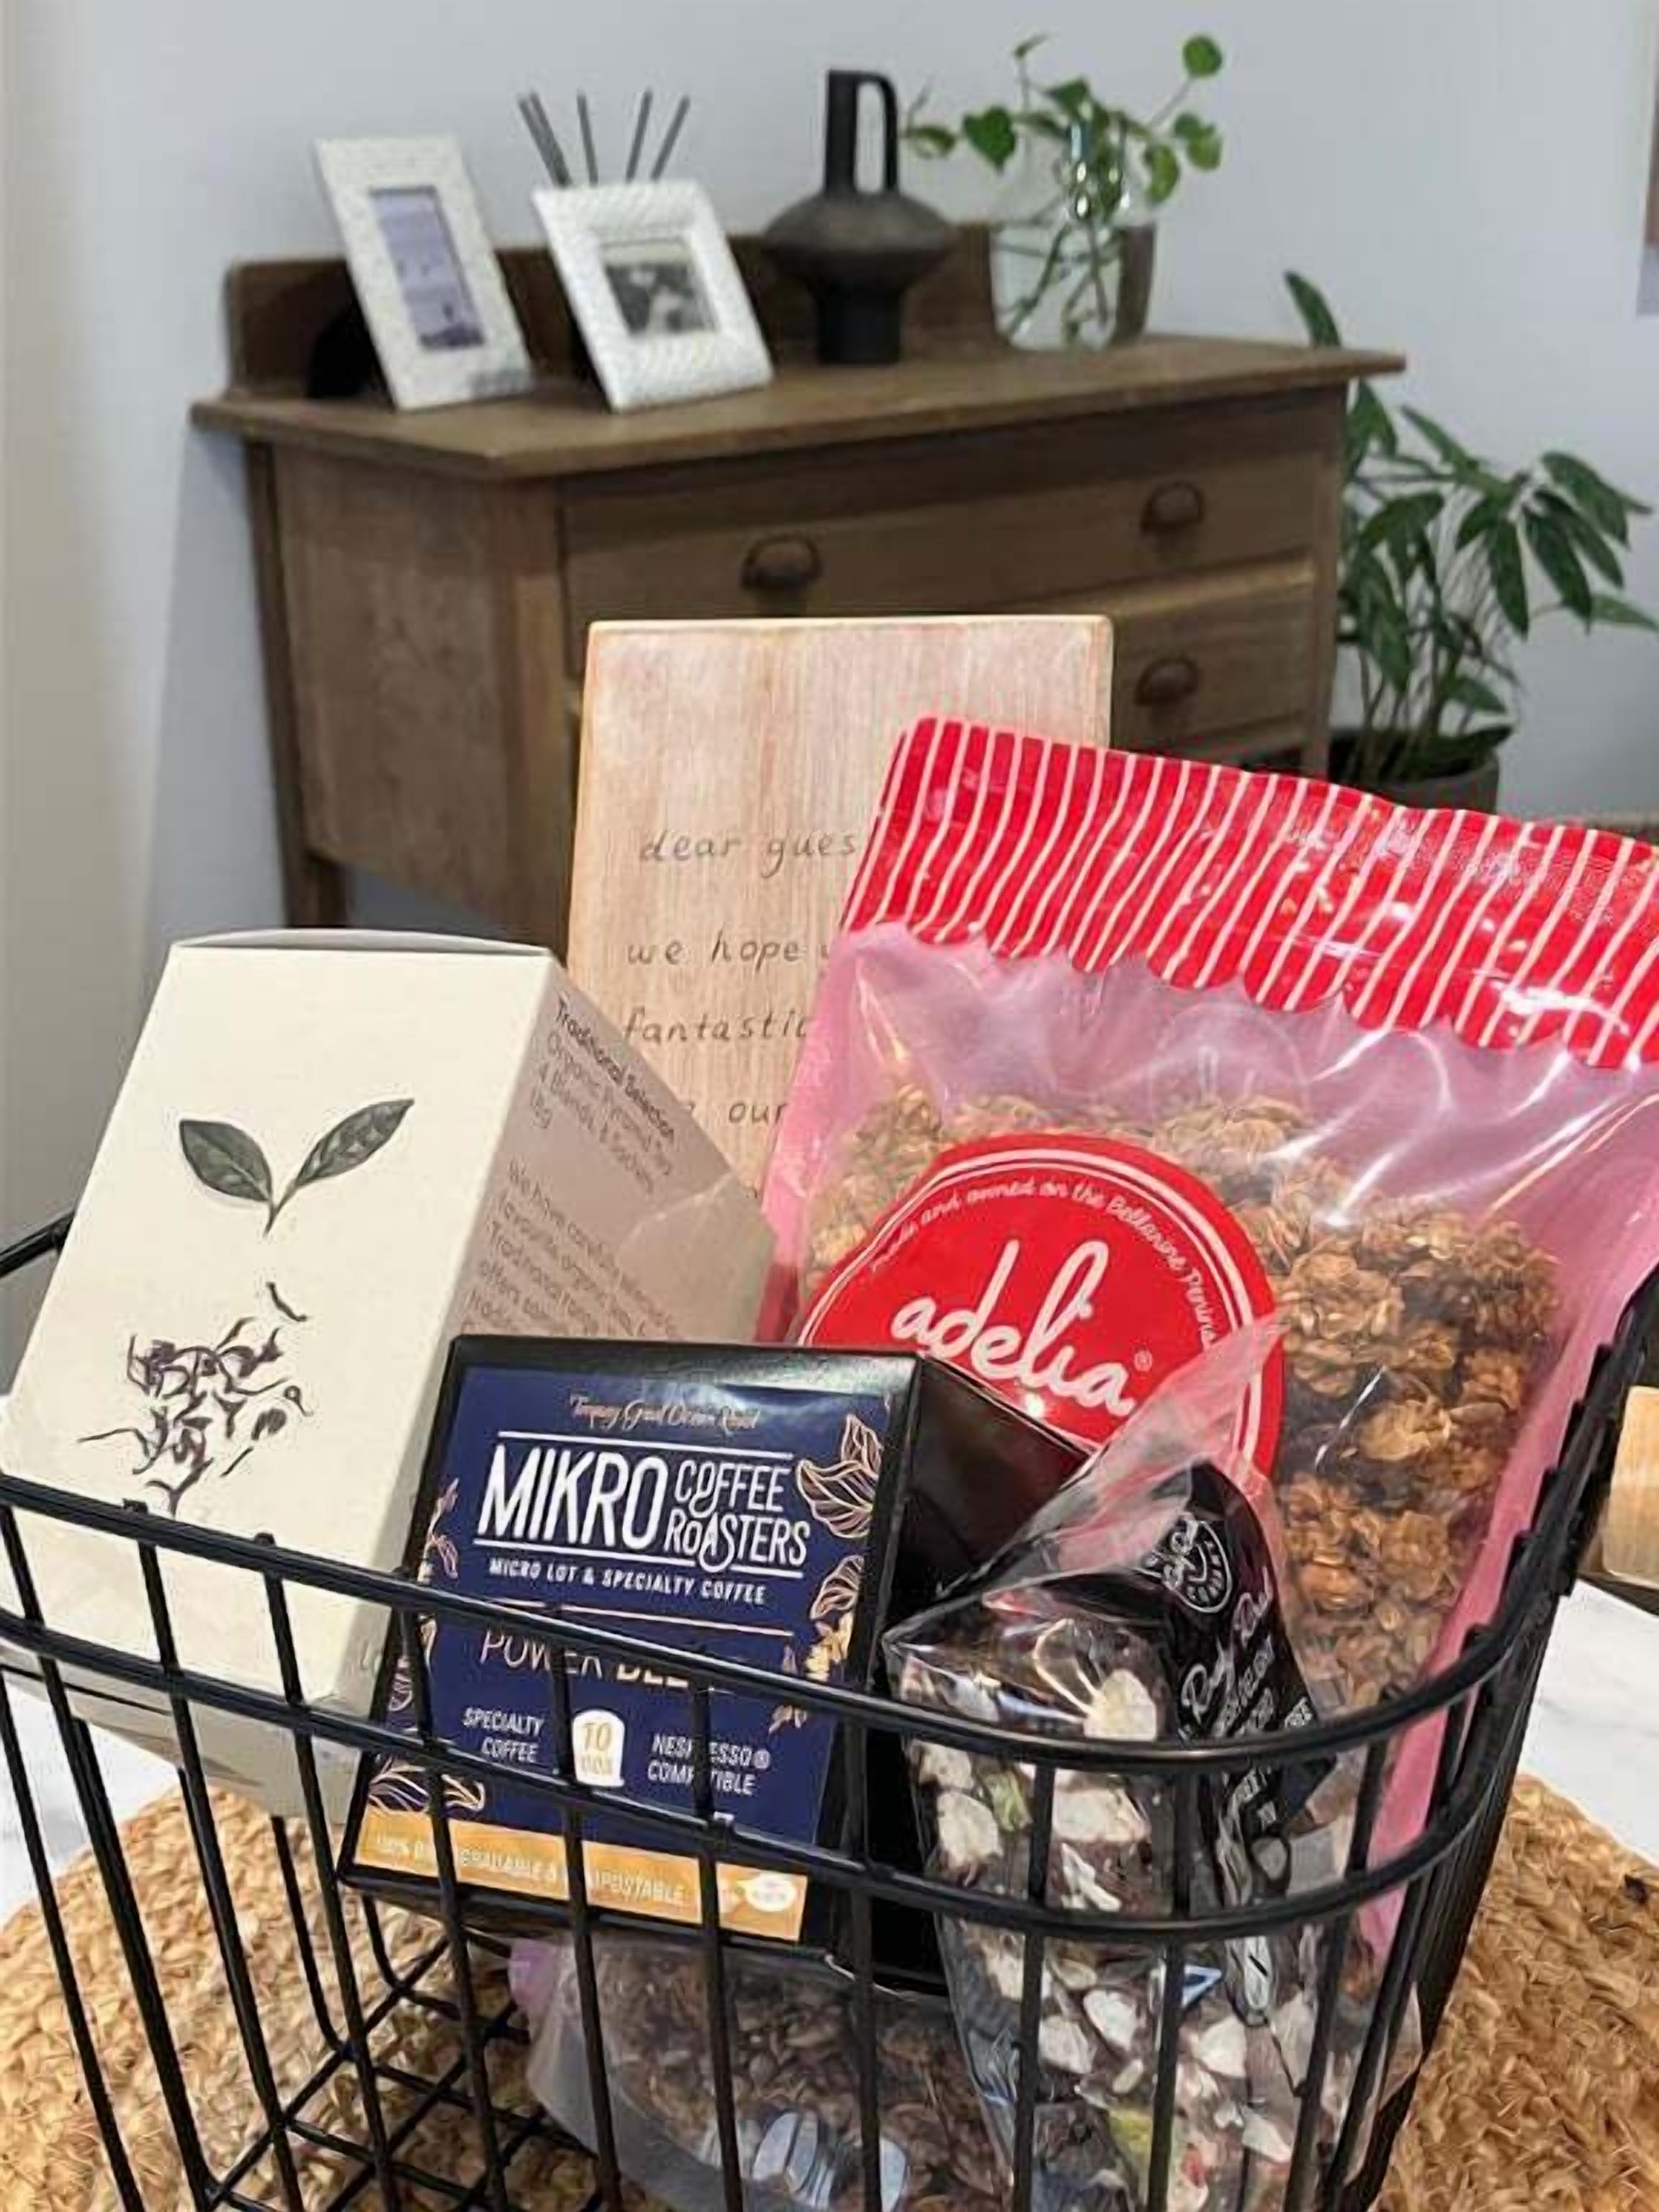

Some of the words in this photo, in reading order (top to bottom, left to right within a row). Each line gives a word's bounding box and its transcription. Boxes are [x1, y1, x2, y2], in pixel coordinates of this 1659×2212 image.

[640, 830, 741, 863] dear
[761, 832, 857, 878] gues
[627, 939, 684, 966] we
[711, 929, 799, 971] hope
[624, 1007, 808, 1043] fantastic
[728, 1101, 789, 1125] our
[890, 1238, 1136, 1417] adelia
[1175, 1267, 1218, 1351] Penins
[477, 1443, 669, 1550] MIKRO
[674, 1459, 791, 1519] COFFEE
[663, 1508, 811, 1573] ROASTERS
[489, 1557, 541, 1580] MICRO
[547, 1562, 578, 1583] LOT
[582, 1566, 595, 1586] &
[601, 1568, 696, 1597] SPECIALTY
[699, 1580, 767, 1606] COFFEE
[463, 1706, 545, 1737] SPECIALTY
[481, 1735, 540, 1764] COFFEE
[651, 1732, 771, 1770] NESESSO®
[647, 1759, 757, 1796] COMTIBLE
